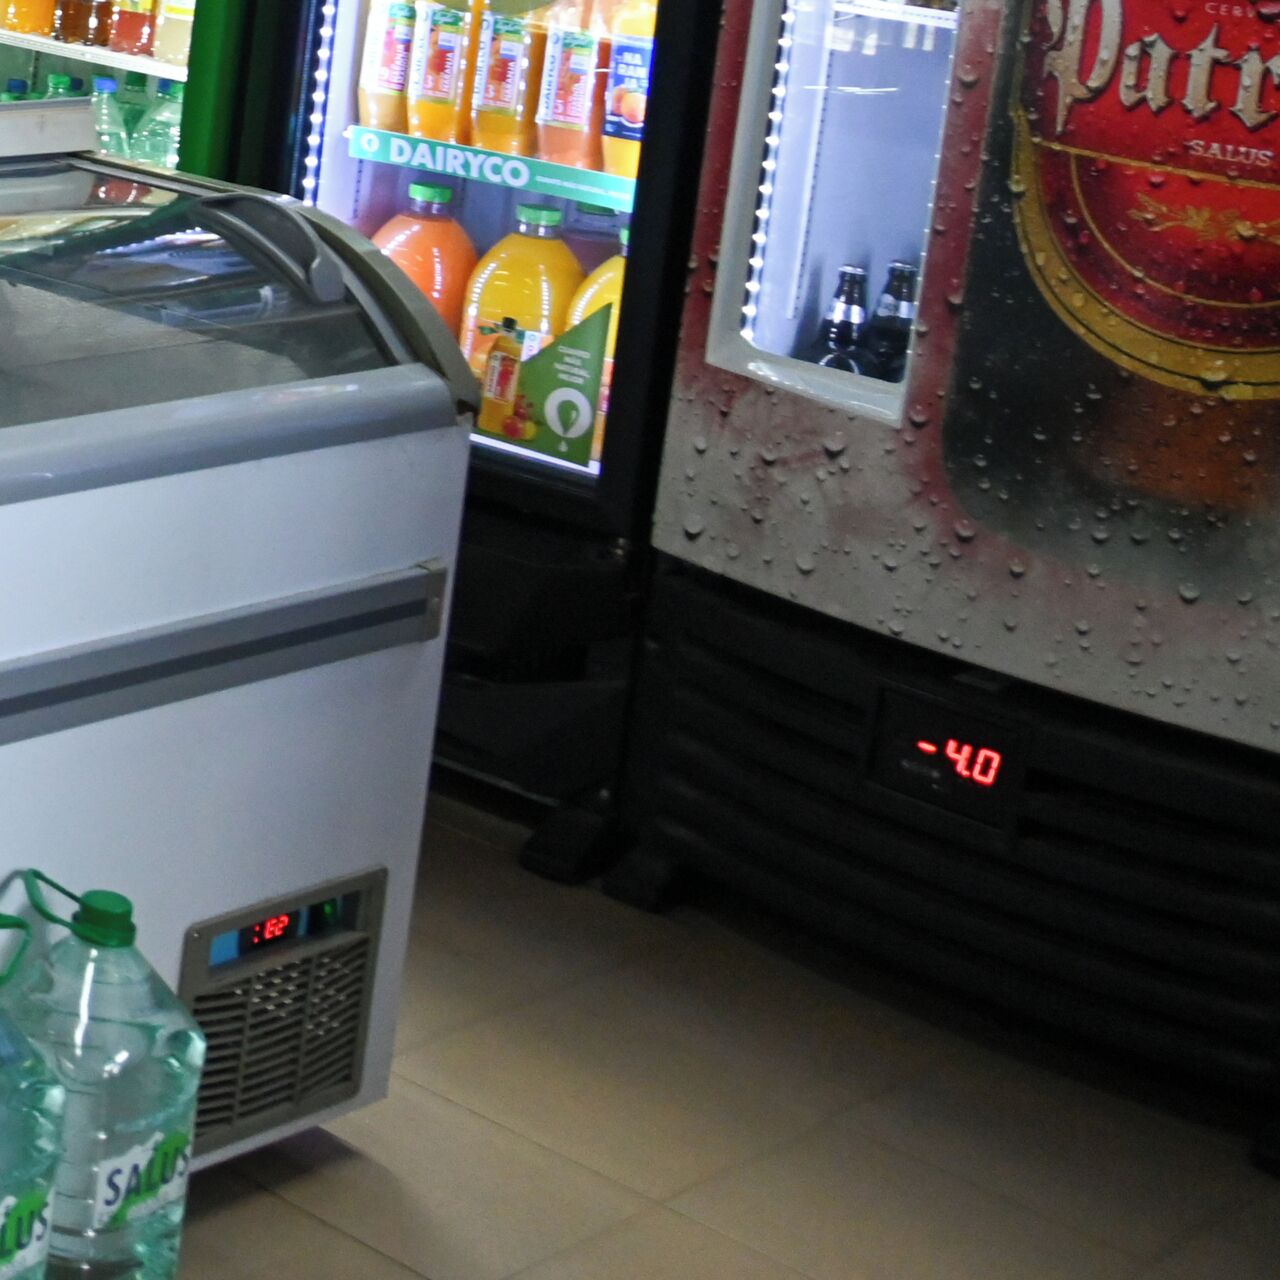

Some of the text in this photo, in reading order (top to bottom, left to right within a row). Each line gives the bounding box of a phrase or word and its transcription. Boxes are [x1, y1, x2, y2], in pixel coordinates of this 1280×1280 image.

[390, 136, 530, 187] DAIRYCO
[1189, 138, 1274, 169] SALUS
[916, 738, 1003, 788] -4.0
[104, 1150, 189, 1207] SALUS
